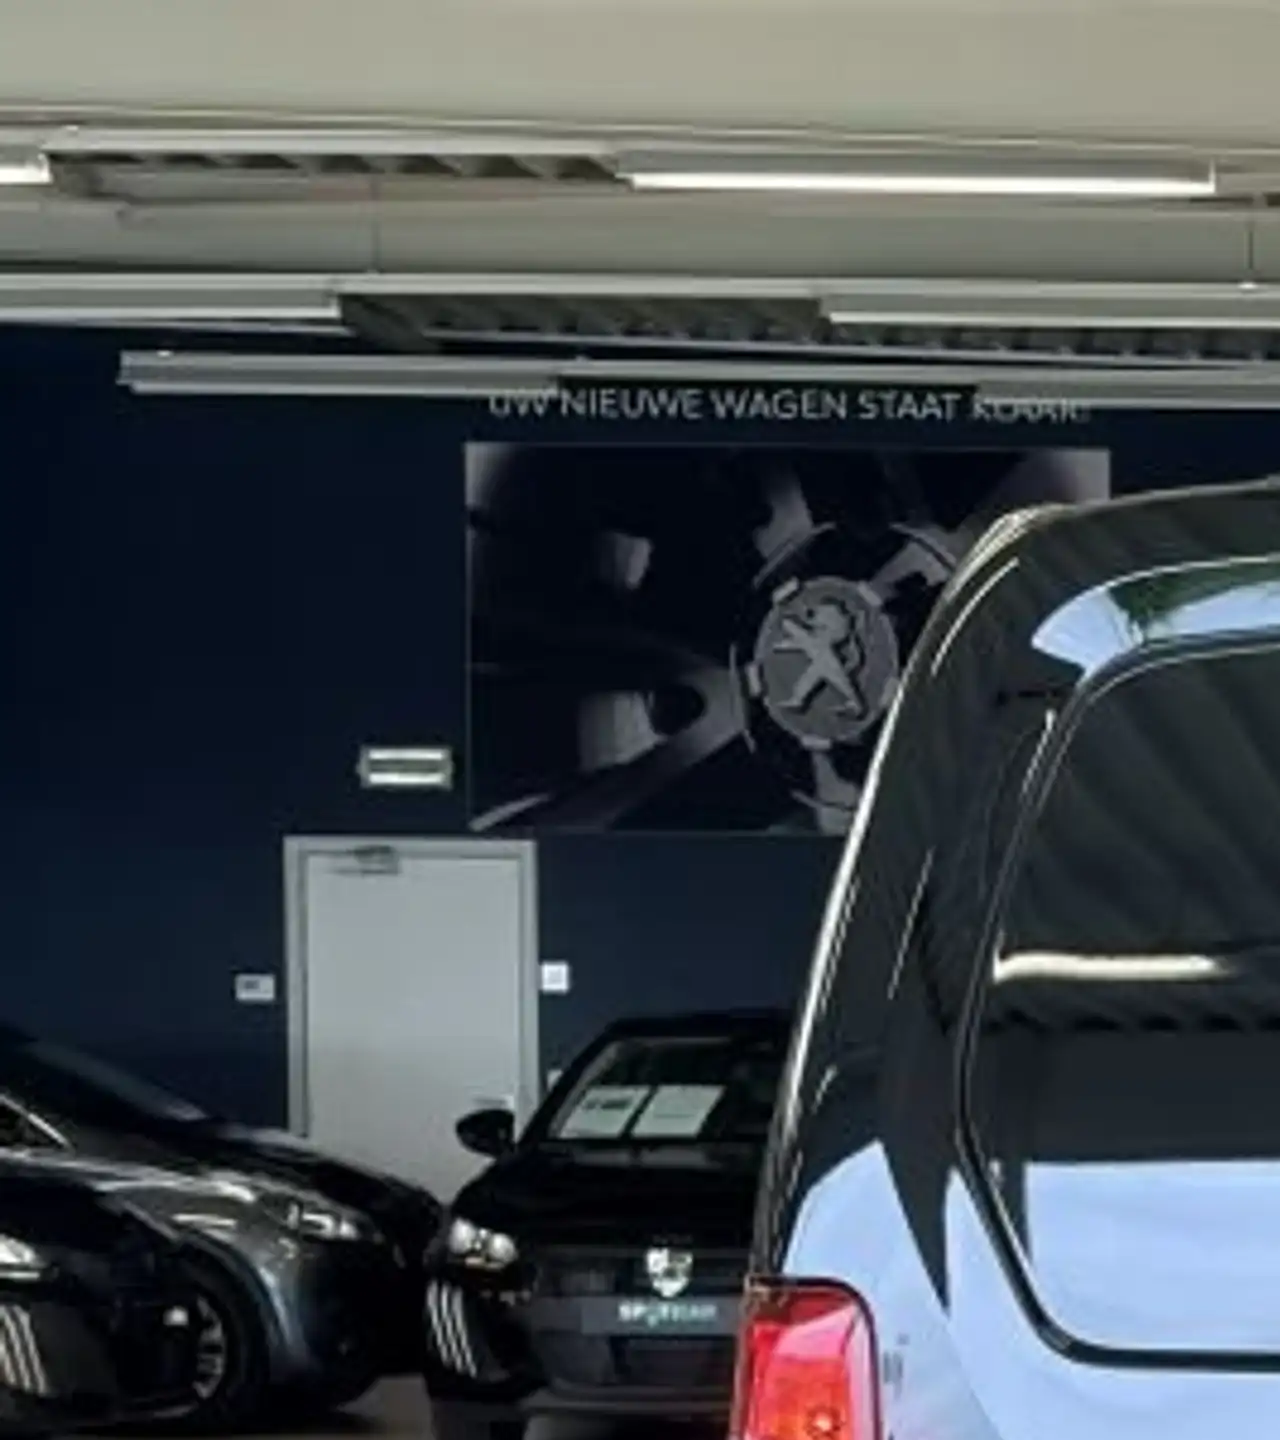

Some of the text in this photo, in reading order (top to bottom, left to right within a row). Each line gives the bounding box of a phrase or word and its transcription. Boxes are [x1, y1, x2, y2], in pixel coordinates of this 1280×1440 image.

[558, 387, 703, 419] NIEUWE
[708, 388, 848, 420] WAGEN
[856, 389, 963, 421] STAAT
